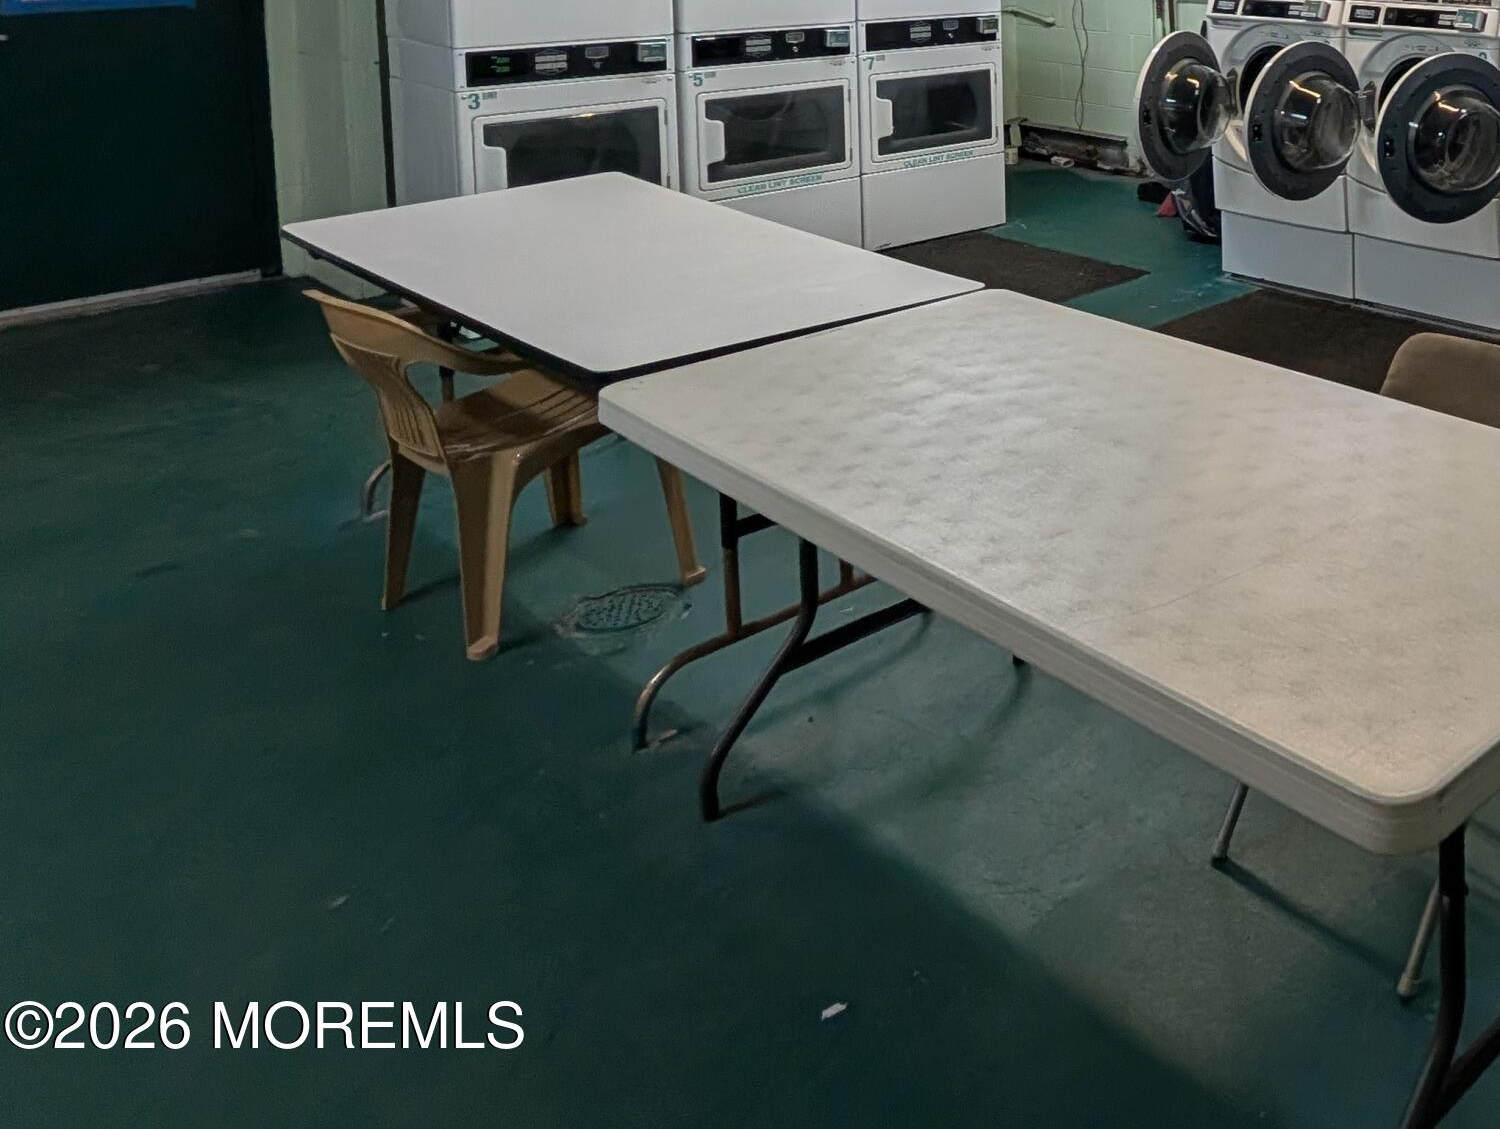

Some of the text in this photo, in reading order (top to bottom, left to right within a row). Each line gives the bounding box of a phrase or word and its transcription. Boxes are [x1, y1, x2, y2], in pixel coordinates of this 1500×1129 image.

[864, 56, 875, 70] 7
[692, 72, 703, 87] 5
[468, 93, 480, 110] 3
